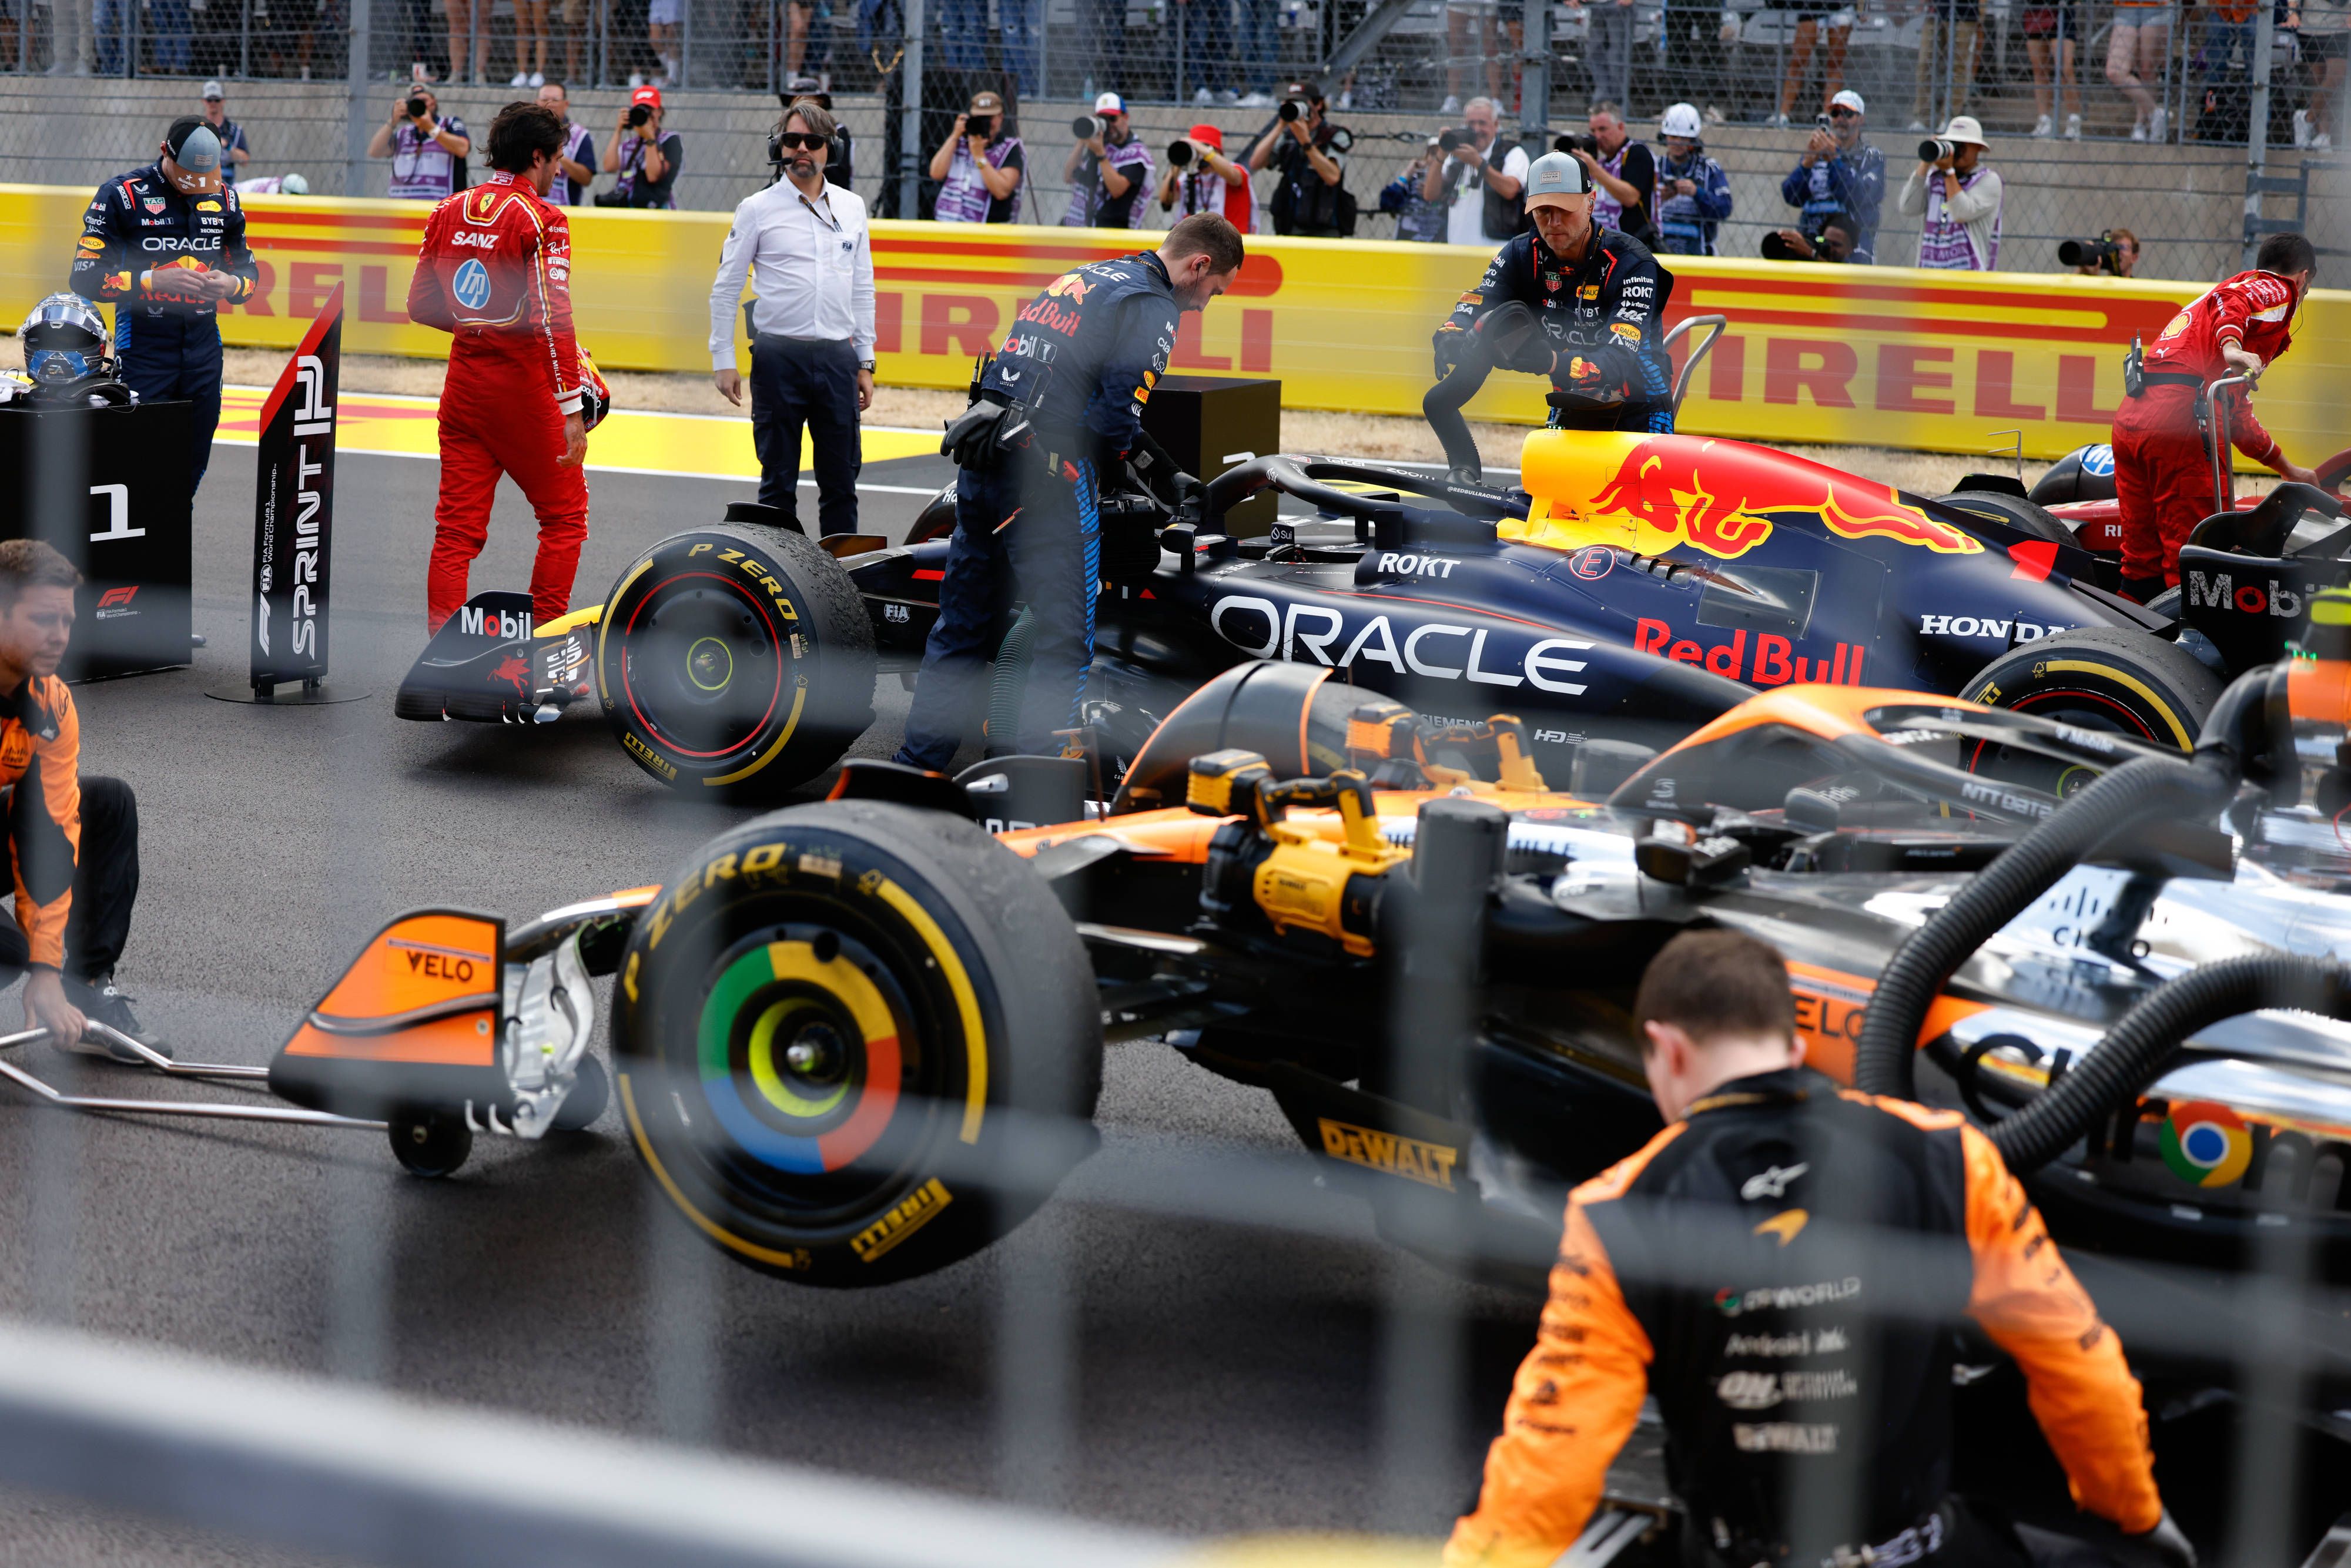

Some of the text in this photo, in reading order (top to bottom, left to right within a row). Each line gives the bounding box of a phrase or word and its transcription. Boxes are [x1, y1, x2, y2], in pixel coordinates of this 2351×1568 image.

[198, 177, 206, 187] 1
[91, 202, 106, 212] Mobil
[142, 218, 165, 226] Mobil
[142, 236, 222, 251] ORACLE
[452, 231, 499, 249] SANZ
[459, 259, 486, 307] hp
[1545, 273, 1560, 282] TAG
[1623, 276, 1653, 285] infinitum
[1542, 298, 1556, 309] obil
[1623, 286, 1653, 299] ROKT
[1619, 326, 1639, 339] RAUCH
[544, 326, 562, 382] RICHARD MILLE
[1158, 337, 1170, 354] Cla
[1447, 486, 1502, 501] @REDBULLRACING
[90, 484, 145, 542] 1
[1280, 531, 1292, 540] Sui
[292, 444, 322, 661] SPRINT
[1583, 550, 1606, 577] E
[1378, 553, 1461, 579] ROKT
[262, 567, 272, 592] FIA
[688, 544, 799, 621] P ZERO
[96, 585, 139, 608] F1
[96, 611, 106, 619] FIA
[259, 591, 270, 657] F1
[461, 606, 531, 641] Mobil
[885, 603, 910, 622] FIA
[1211, 595, 1597, 696] ORACLE
[1633, 617, 1864, 687] Red Bull
[624, 732, 678, 781] PIRELLI
[1962, 782, 2001, 805] NTT
[647, 842, 787, 950] ZERO
[406, 950, 473, 983] VELO
[1318, 1118, 1458, 1193] DEWALT
[850, 1177, 954, 1263] PIRELLI
